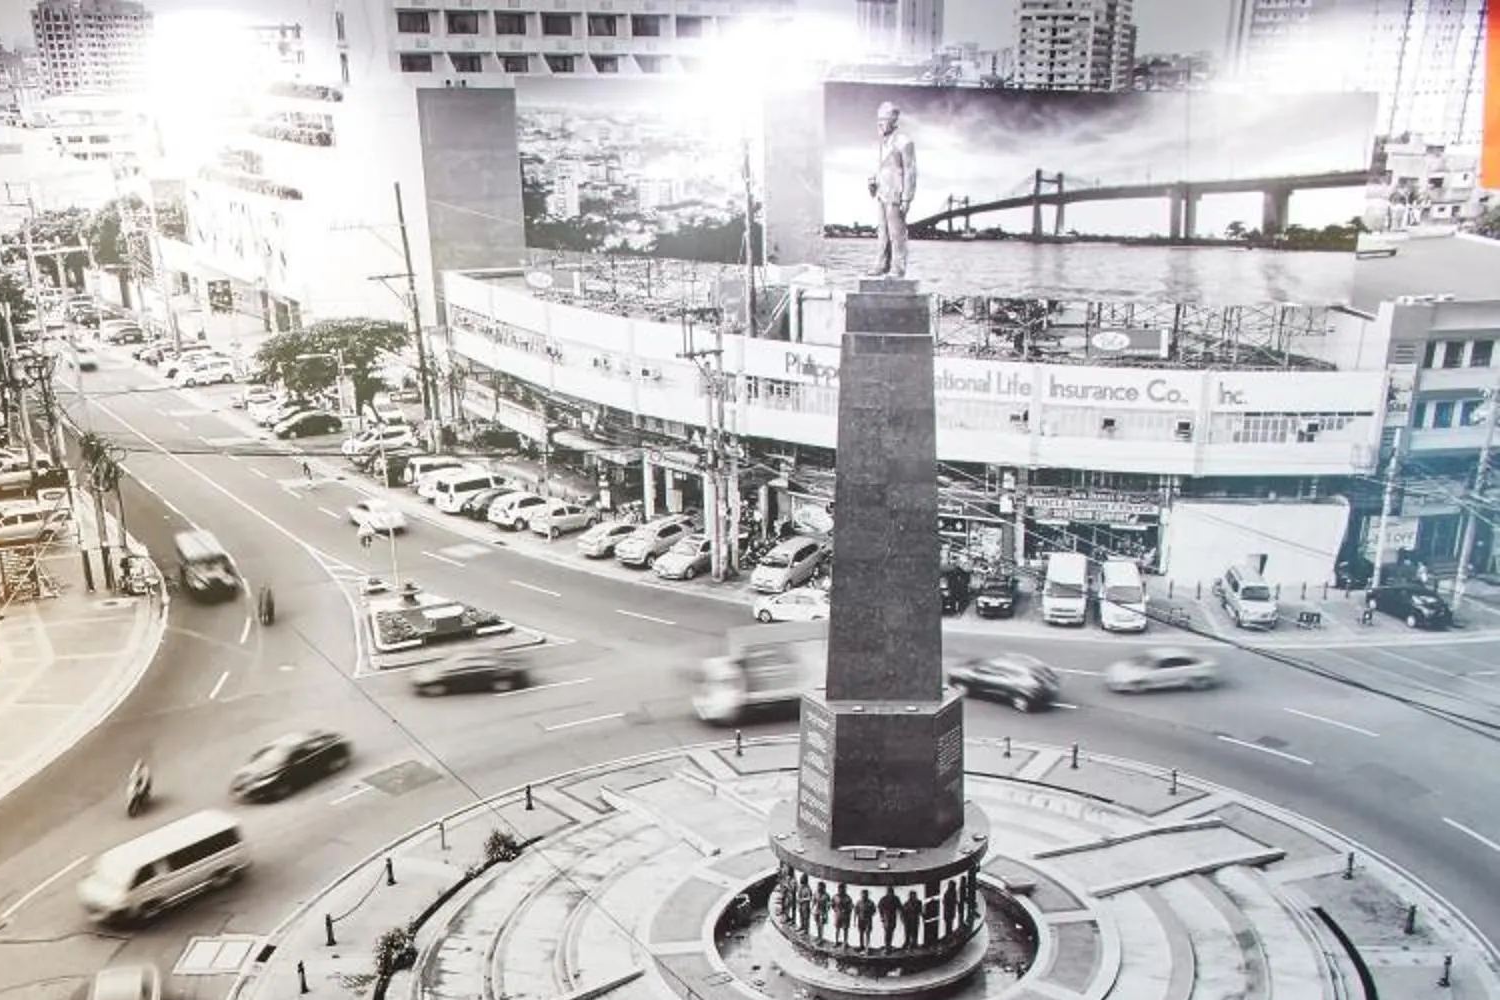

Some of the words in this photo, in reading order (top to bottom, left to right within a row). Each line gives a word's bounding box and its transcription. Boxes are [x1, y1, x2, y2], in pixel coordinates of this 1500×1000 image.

[933, 368, 992, 394] ational
[997, 371, 1032, 396] Life
[1049, 373, 1139, 401] Insurance
